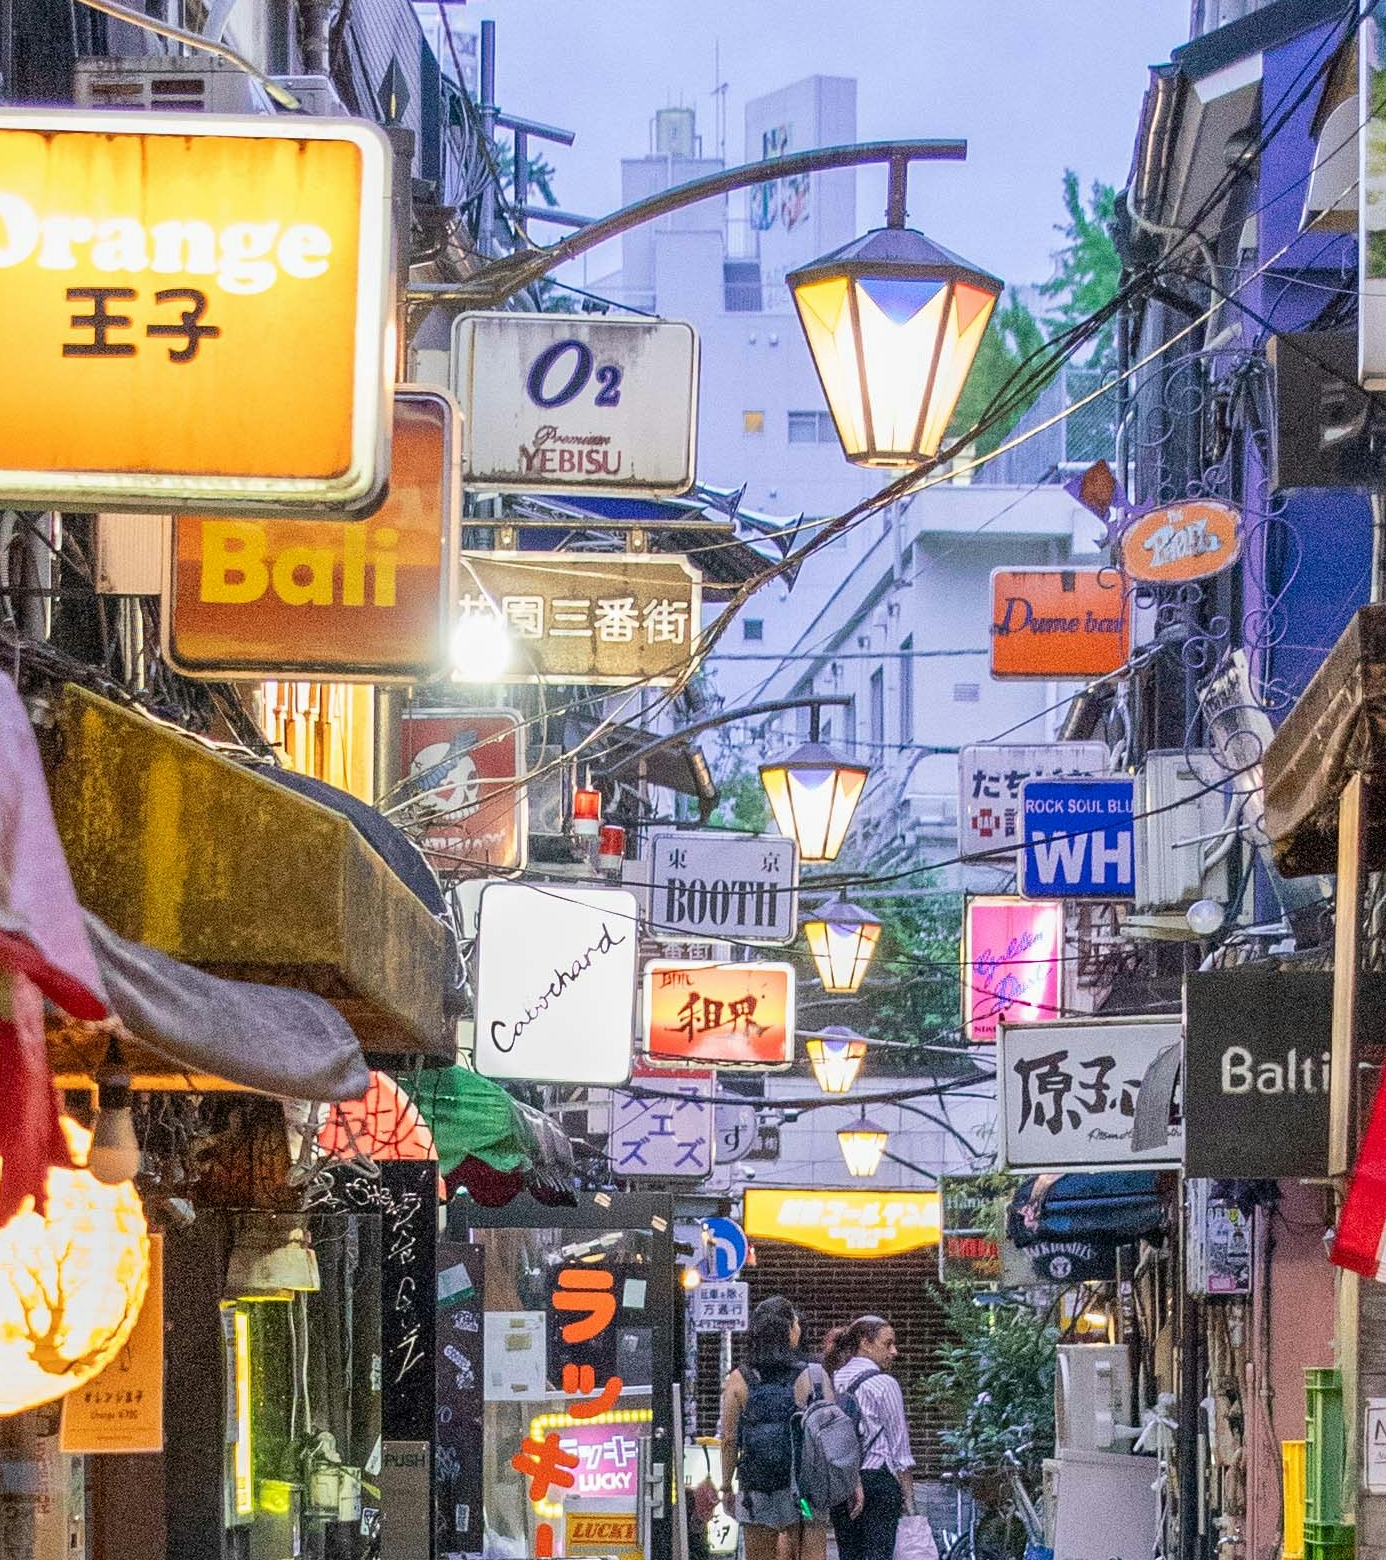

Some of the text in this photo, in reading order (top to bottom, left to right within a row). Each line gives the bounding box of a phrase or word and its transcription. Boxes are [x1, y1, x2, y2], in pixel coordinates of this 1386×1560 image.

[61, 287, 221, 363] 王子
[518, 445, 622, 475] YEBISU
[200, 523, 398, 607] Bali
[1026, 799, 1063, 813] ROCK
[1068, 799, 1103, 813] SOUL
[665, 878, 778, 928] BOOTH
[384, 1454, 425, 1467] PUSH
[579, 1472, 632, 1492] LUCKY
